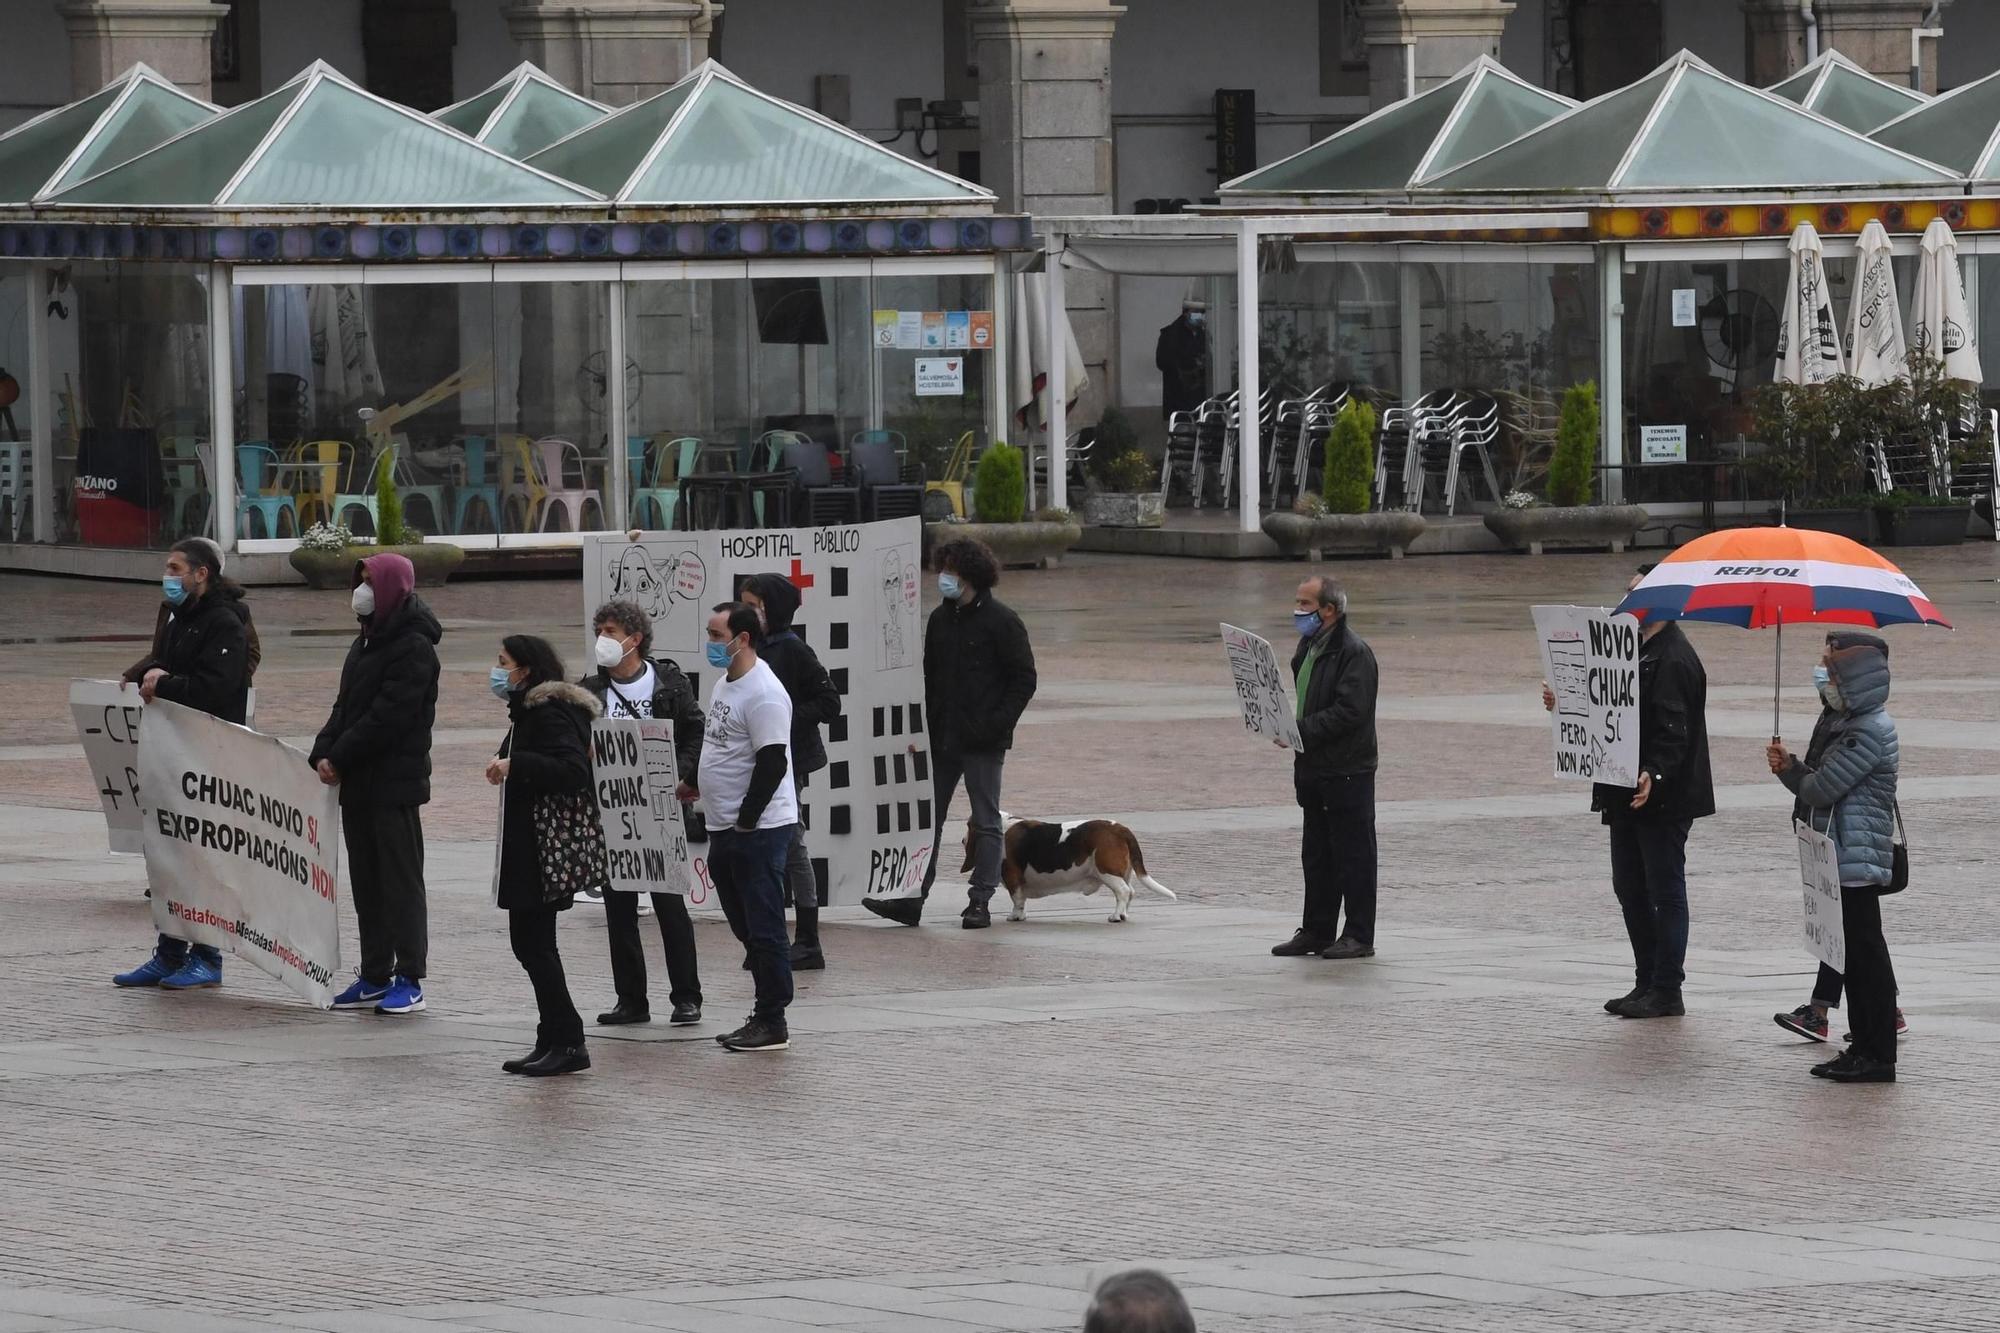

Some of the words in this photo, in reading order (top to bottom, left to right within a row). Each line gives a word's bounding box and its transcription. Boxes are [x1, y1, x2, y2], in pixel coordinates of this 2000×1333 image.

[721, 534, 802, 558] HOSPITAL
[814, 527, 860, 553] PÚBLICO
[1714, 566, 1800, 577] REPSOL
[1588, 619, 1634, 661] NOVO
[1588, 667, 1635, 707] CHUAC
[614, 700, 652, 711] NVO
[593, 730, 638, 767] NOVO
[1561, 722, 1587, 746] PERO
[1557, 751, 1577, 774] NON
[182, 771, 256, 816] CHUAC
[260, 793, 303, 837] NOVO
[599, 775, 648, 809] CHUAC
[157, 808, 308, 885] EXPROPIACIÓNS
[609, 849, 642, 880] PERO
[642, 848, 666, 883] NON
[868, 846, 907, 893] PERO
